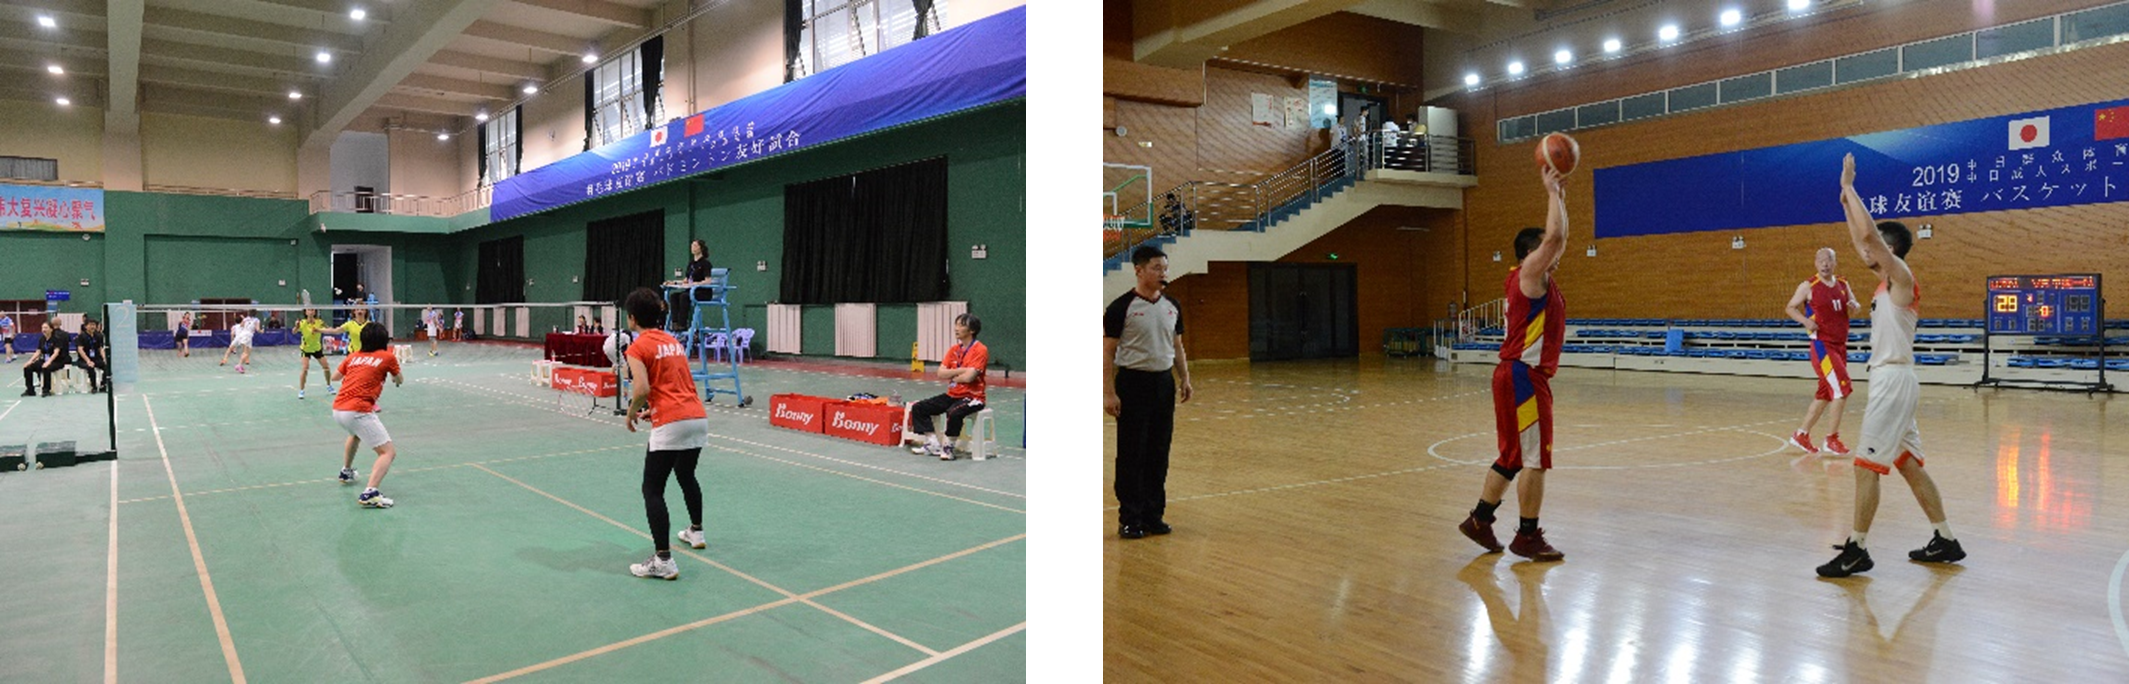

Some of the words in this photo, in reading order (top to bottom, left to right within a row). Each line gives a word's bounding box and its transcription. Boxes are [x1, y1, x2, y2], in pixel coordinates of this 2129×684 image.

[1912, 163, 1960, 187] 2019
[1861, 188, 1962, 215] 球友谊赛
[1981, 176, 2116, 201] バスケット
[1832, 299, 1842, 312] 11
[114, 306, 131, 328] 2
[348, 355, 383, 368] JAPAN
[775, 403, 814, 425] Bonny
[832, 410, 879, 436] Bonny
